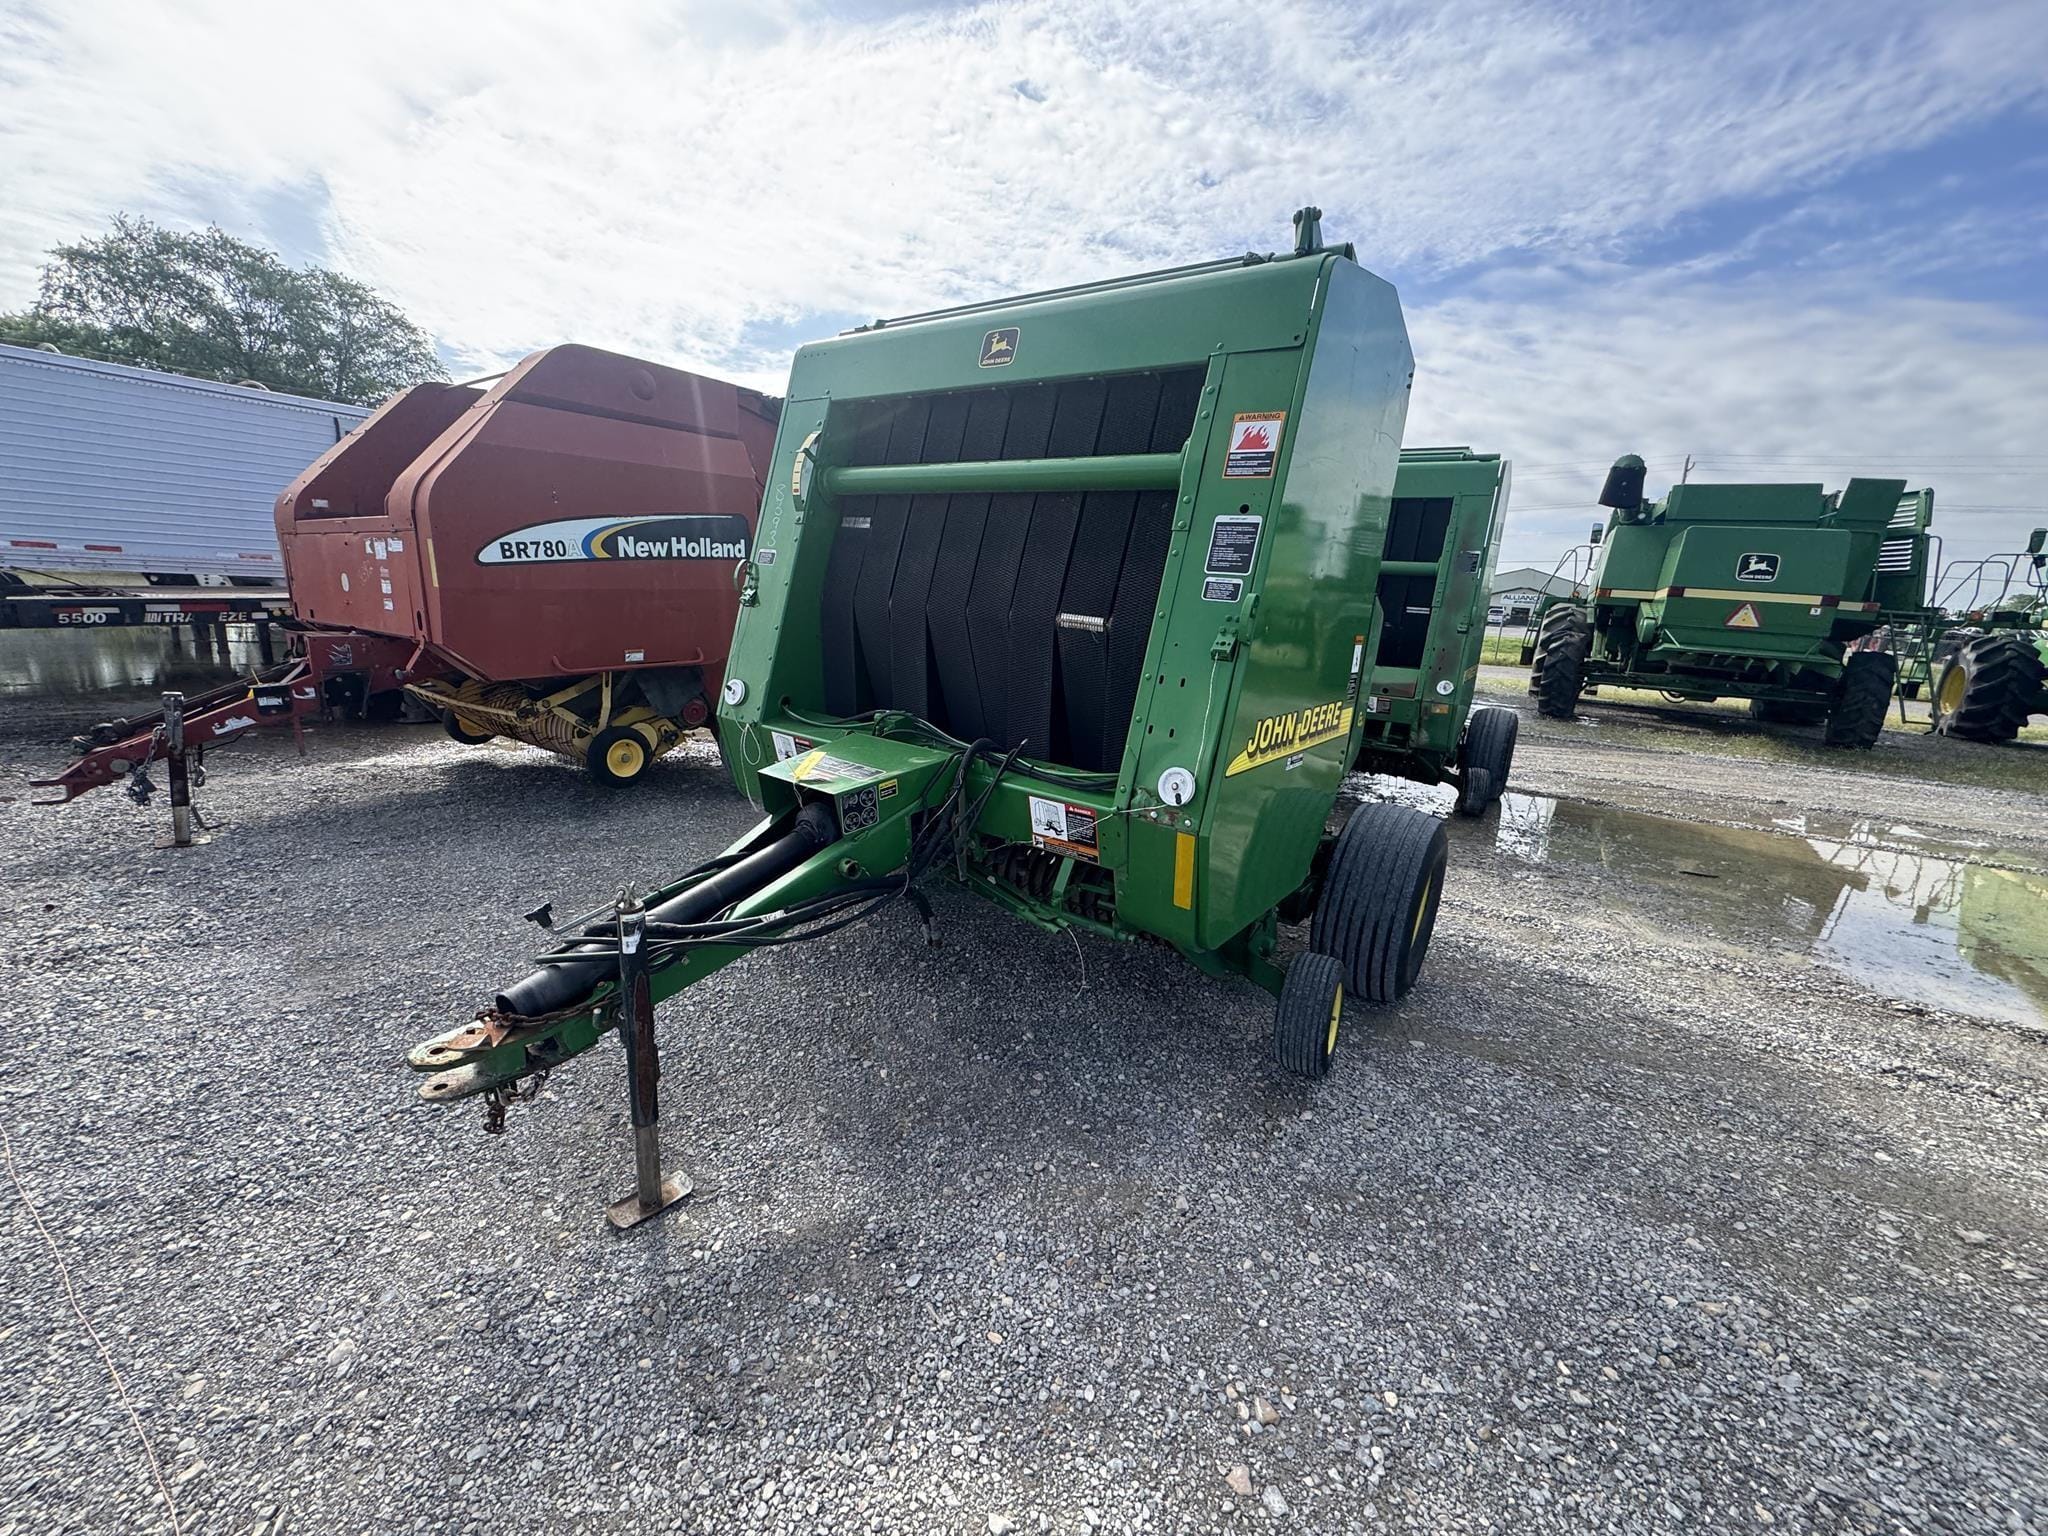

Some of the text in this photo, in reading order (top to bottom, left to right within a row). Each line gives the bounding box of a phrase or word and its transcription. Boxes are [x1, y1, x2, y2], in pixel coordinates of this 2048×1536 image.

[1245, 412, 1281, 420] WARNING
[499, 539, 582, 559] BR780A
[617, 536, 746, 558] New Holland
[58, 612, 107, 624] 5500
[1247, 710, 1299, 755] JOHN
[1299, 700, 1343, 738] DEERE
